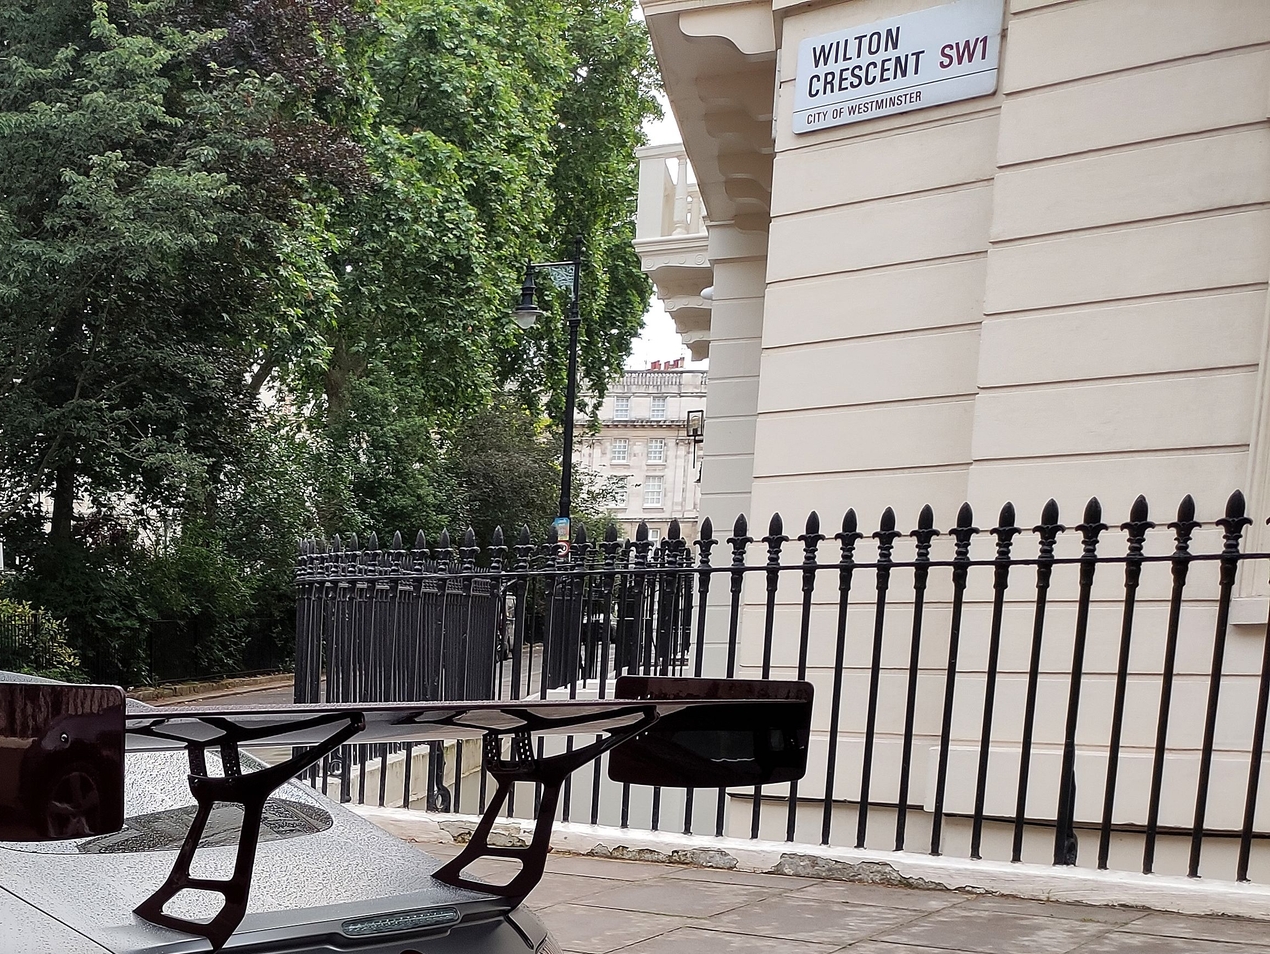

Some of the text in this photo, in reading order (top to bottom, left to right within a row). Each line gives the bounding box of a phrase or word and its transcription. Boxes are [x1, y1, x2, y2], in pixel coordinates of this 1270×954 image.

[808, 35, 989, 98] CRESCENT SW1
[812, 26, 901, 69] WILTON
[806, 91, 922, 125] CITY OF WESTMINSTER
